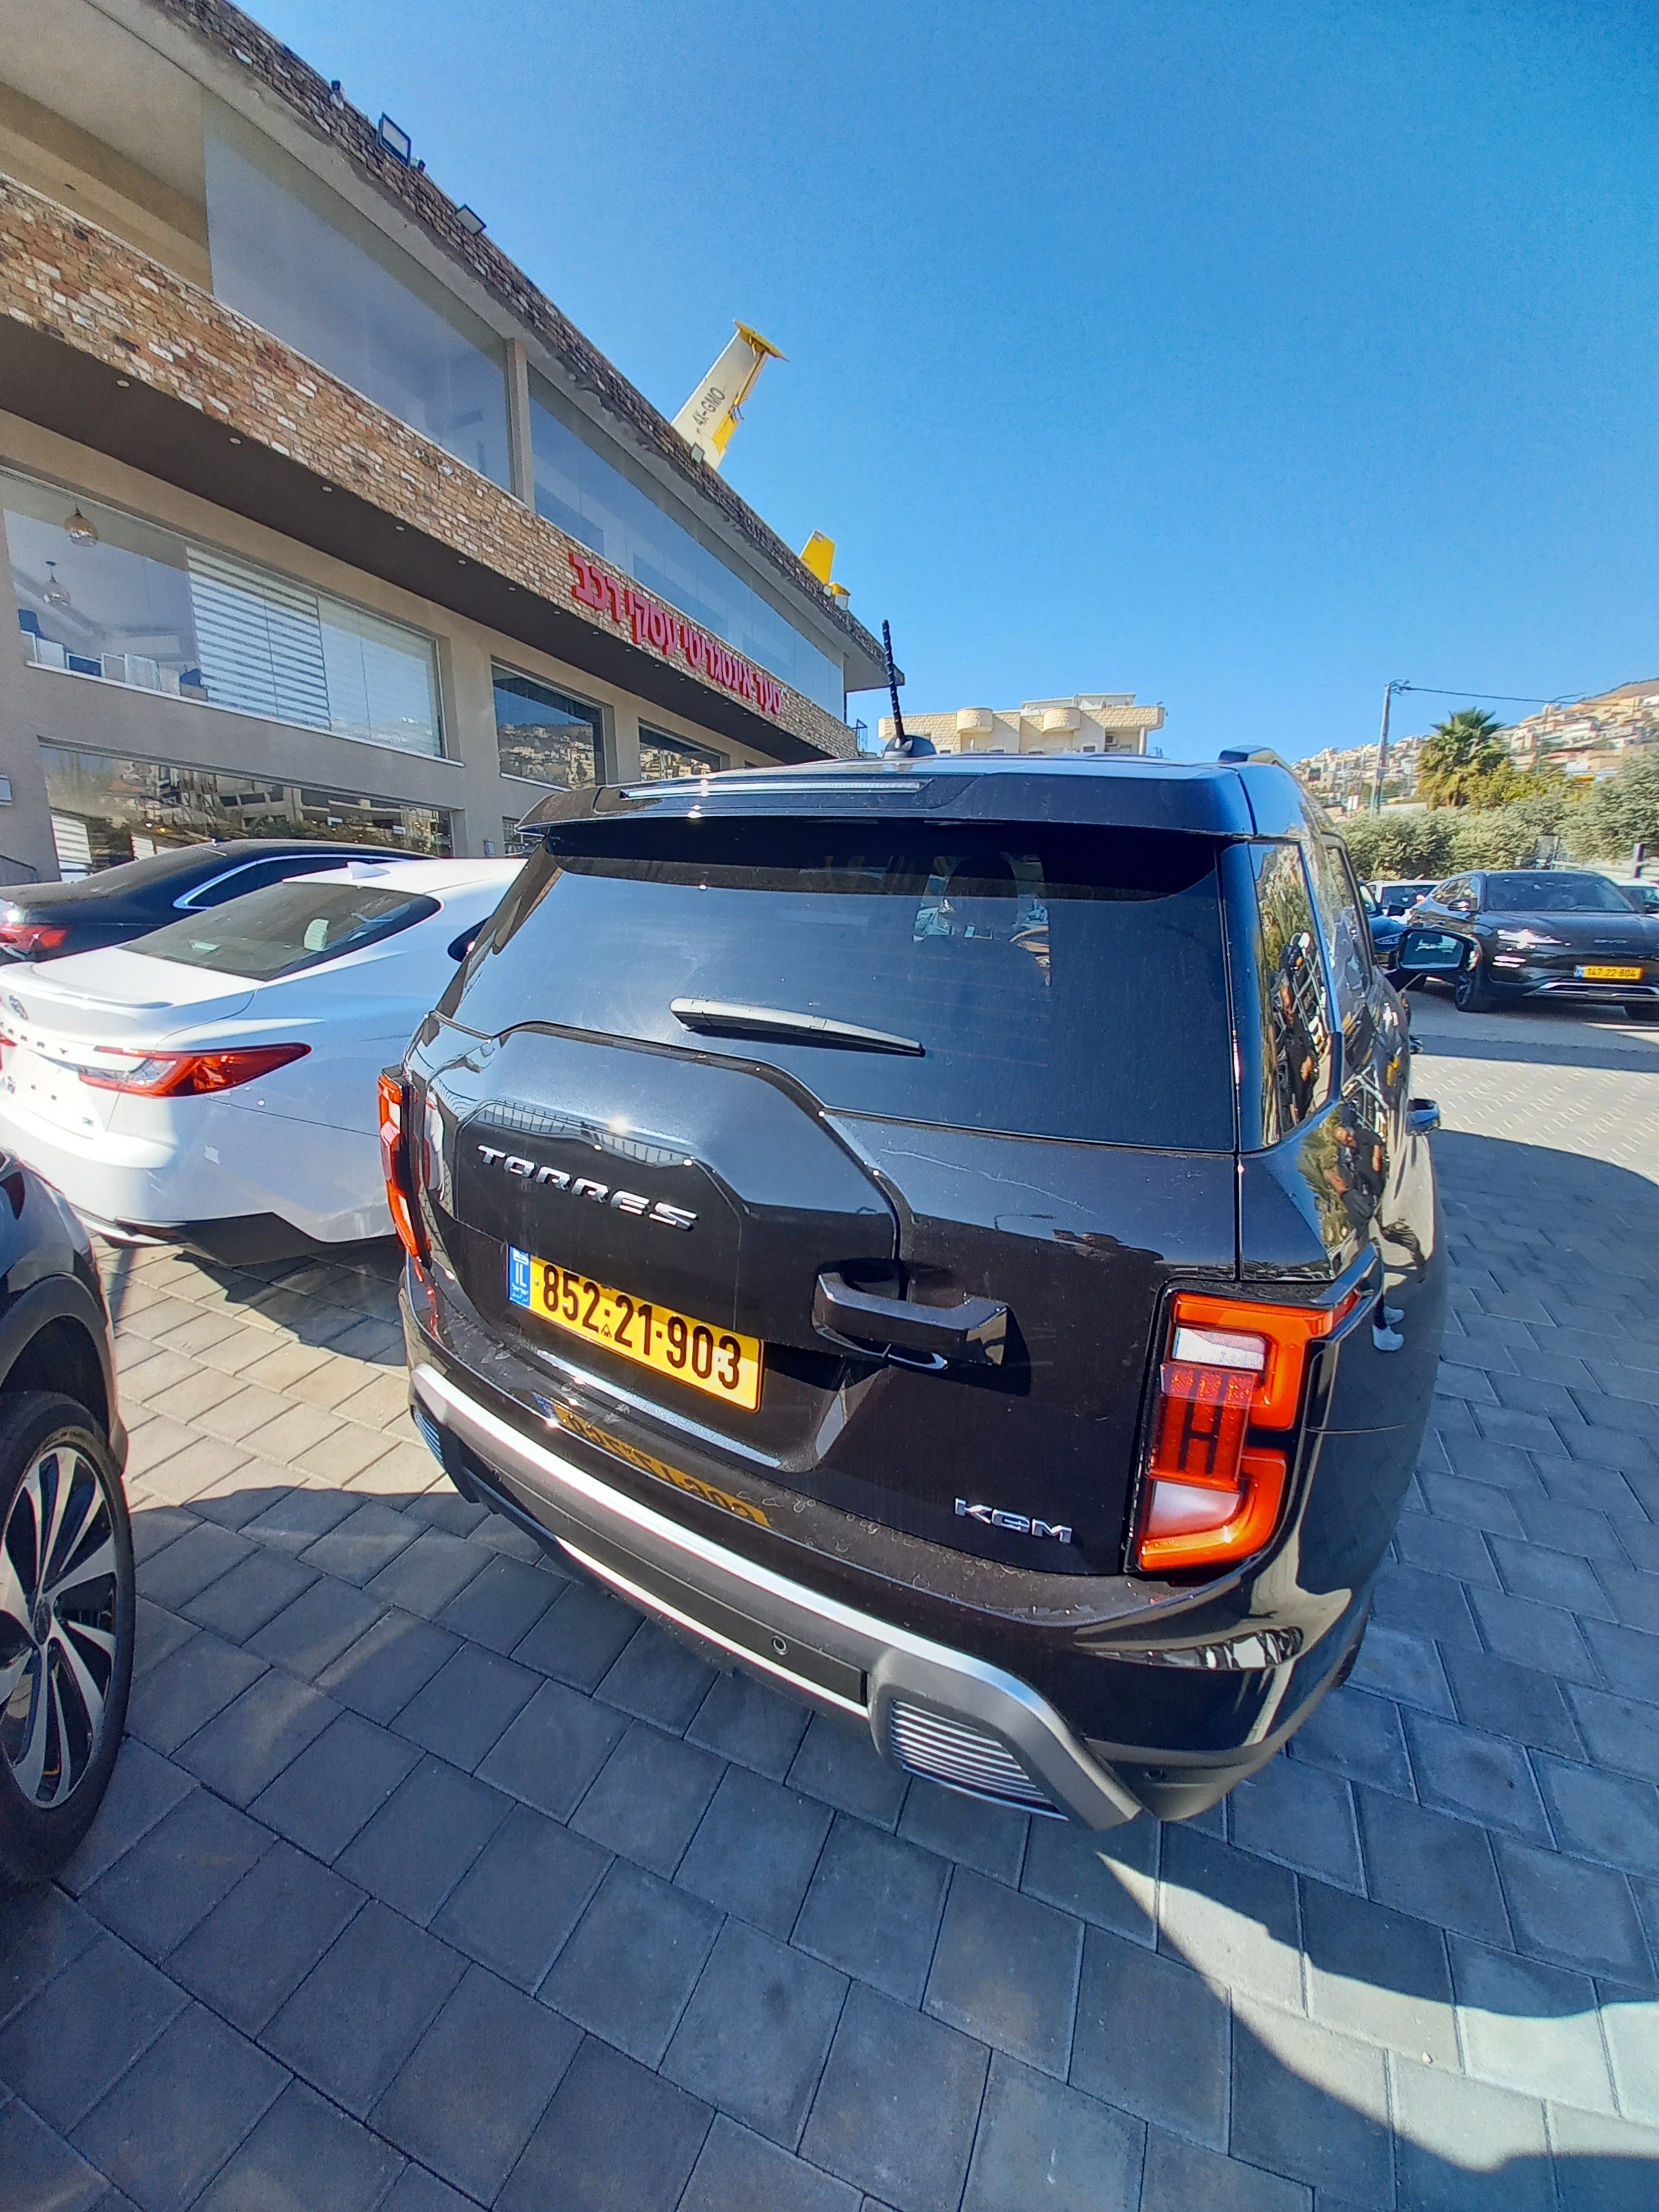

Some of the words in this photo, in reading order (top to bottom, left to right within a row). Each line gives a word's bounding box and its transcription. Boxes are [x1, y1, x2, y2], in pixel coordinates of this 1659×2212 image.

[692, 387, 725, 426] 4X-GMO
[569, 552, 622, 623] רכב
[624, 589, 678, 656] עסקי
[477, 1144, 699, 1231] TORRES
[516, 1261, 527, 1288] IL
[954, 1497, 1073, 1544] KGM
